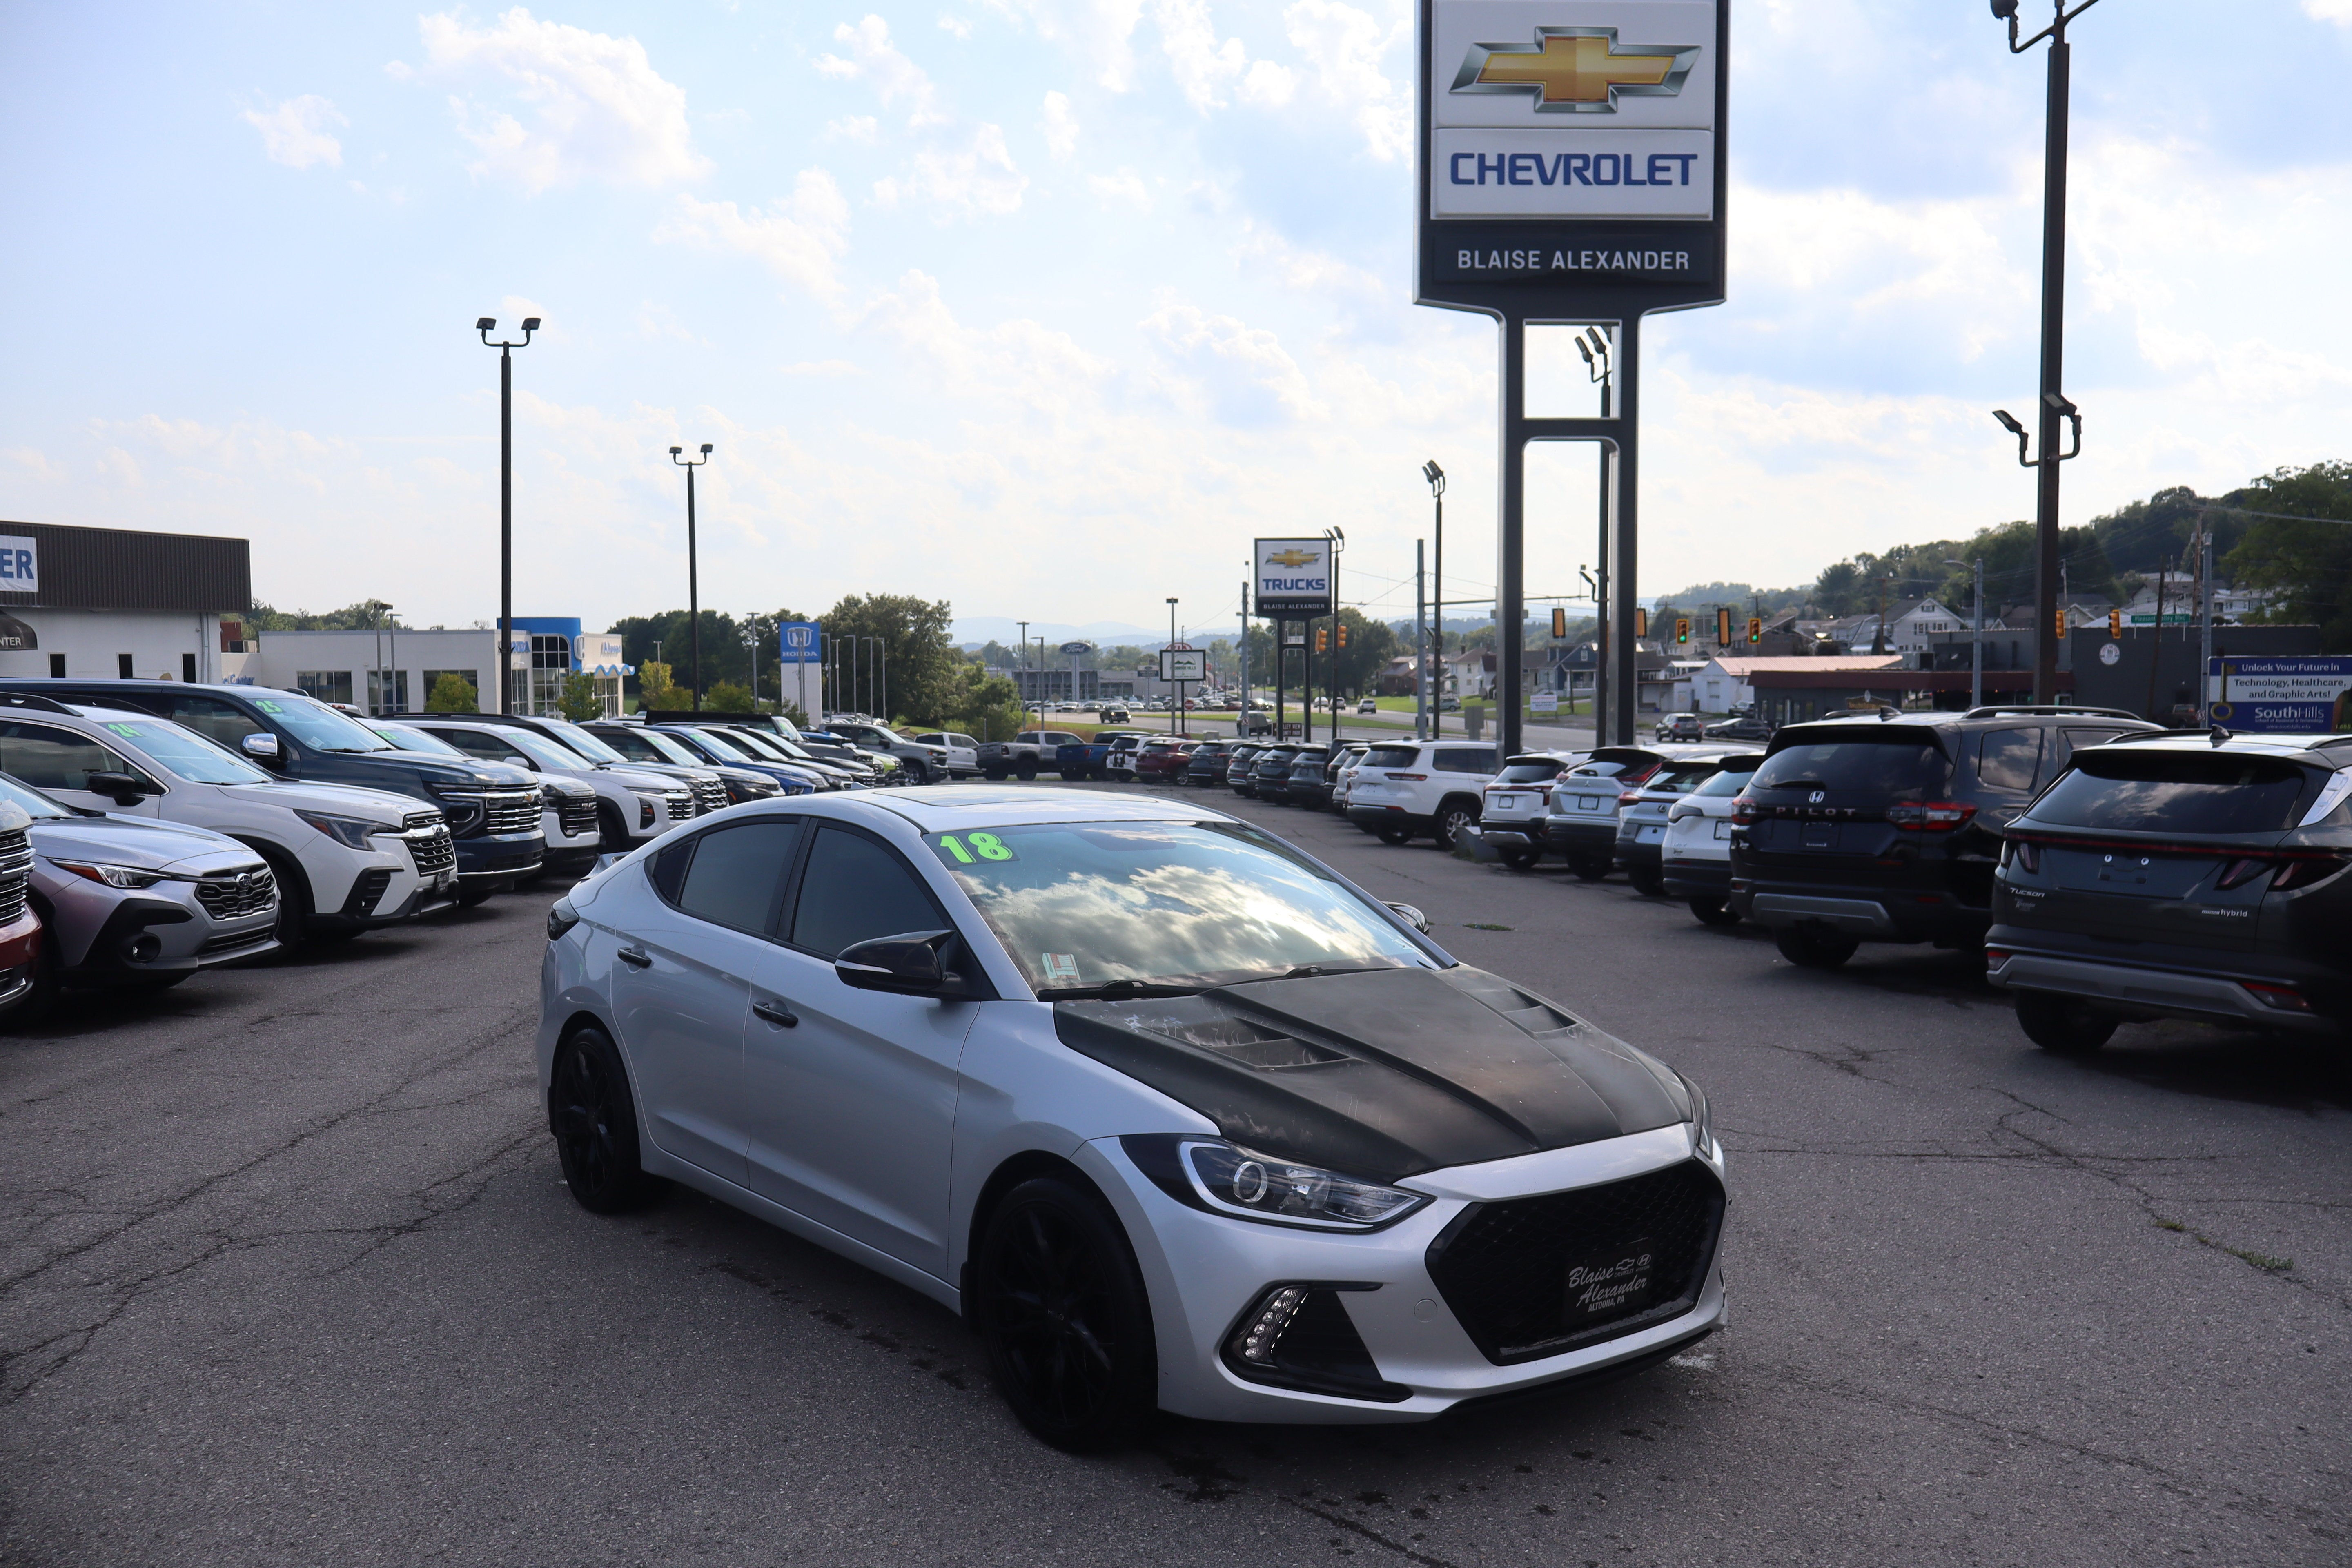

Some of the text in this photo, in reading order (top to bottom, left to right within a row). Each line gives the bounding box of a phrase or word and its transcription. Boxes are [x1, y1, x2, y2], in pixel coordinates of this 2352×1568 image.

[1450, 153, 1698, 186] CHEVROLET
[1457, 250, 1689, 270] BLAISE ALEXANDER
[1263, 579, 1325, 590] TRUCKS
[1066, 644, 1085, 653] Ford
[2242, 663, 2273, 671] Unlock
[2234, 678, 2346, 688] Technology, Healthcare,
[2249, 690, 2330, 700] and Graphic Arts!
[255, 700, 283, 713] 25
[107, 724, 143, 737] 24
[1777, 807, 1855, 816] PILOT
[940, 832, 1013, 863] 18
[2221, 909, 2248, 918] hybrid
[1568, 1266, 1614, 1288] Blaise
[1576, 1274, 1647, 1307] Alexander
[1588, 1295, 1625, 1312] ALTOONA, PA
